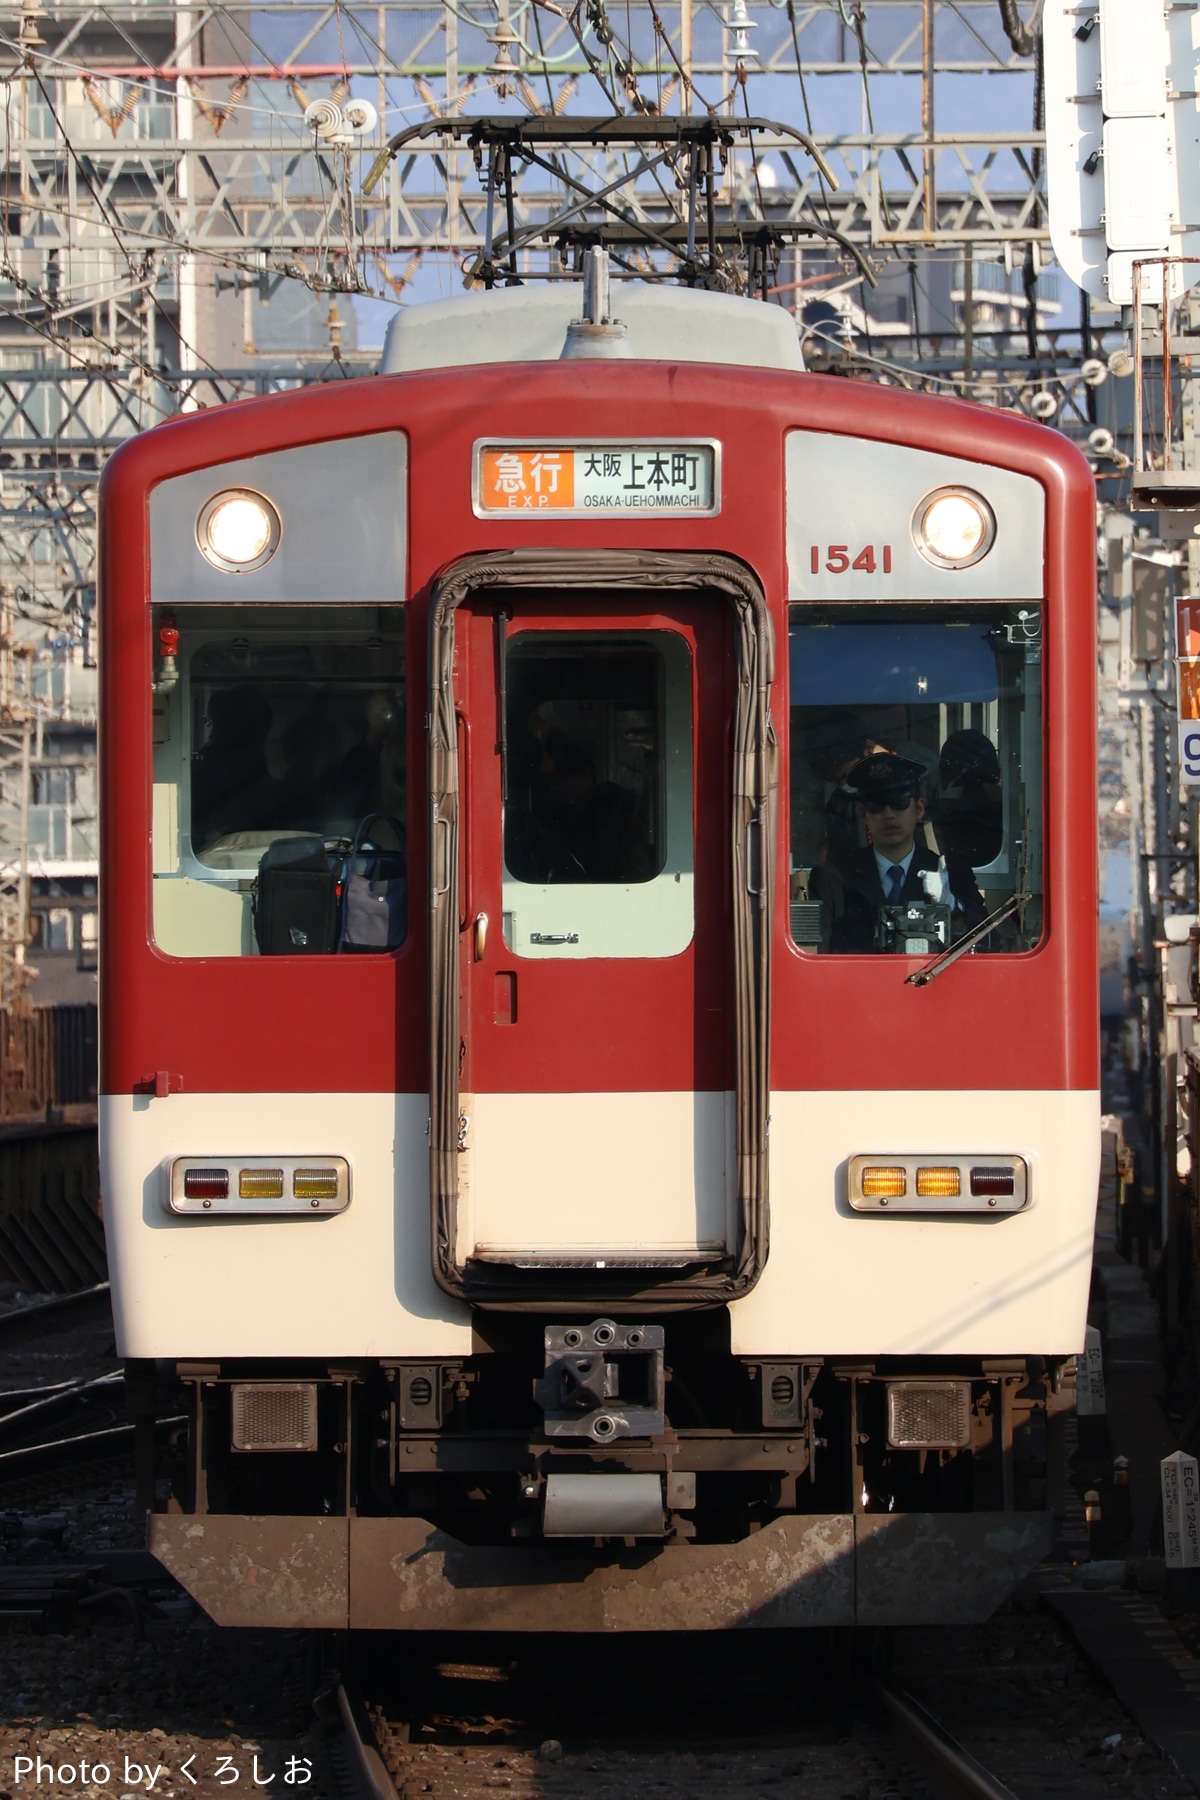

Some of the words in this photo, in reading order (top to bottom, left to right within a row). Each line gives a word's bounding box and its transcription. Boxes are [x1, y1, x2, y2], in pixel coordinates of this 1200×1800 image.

[494, 452, 562, 493] 急行
[584, 452, 700, 492] 大阪上本町
[584, 495, 700, 508] OSAKA-UEHOMMACHI
[810, 544, 892, 575] 1541
